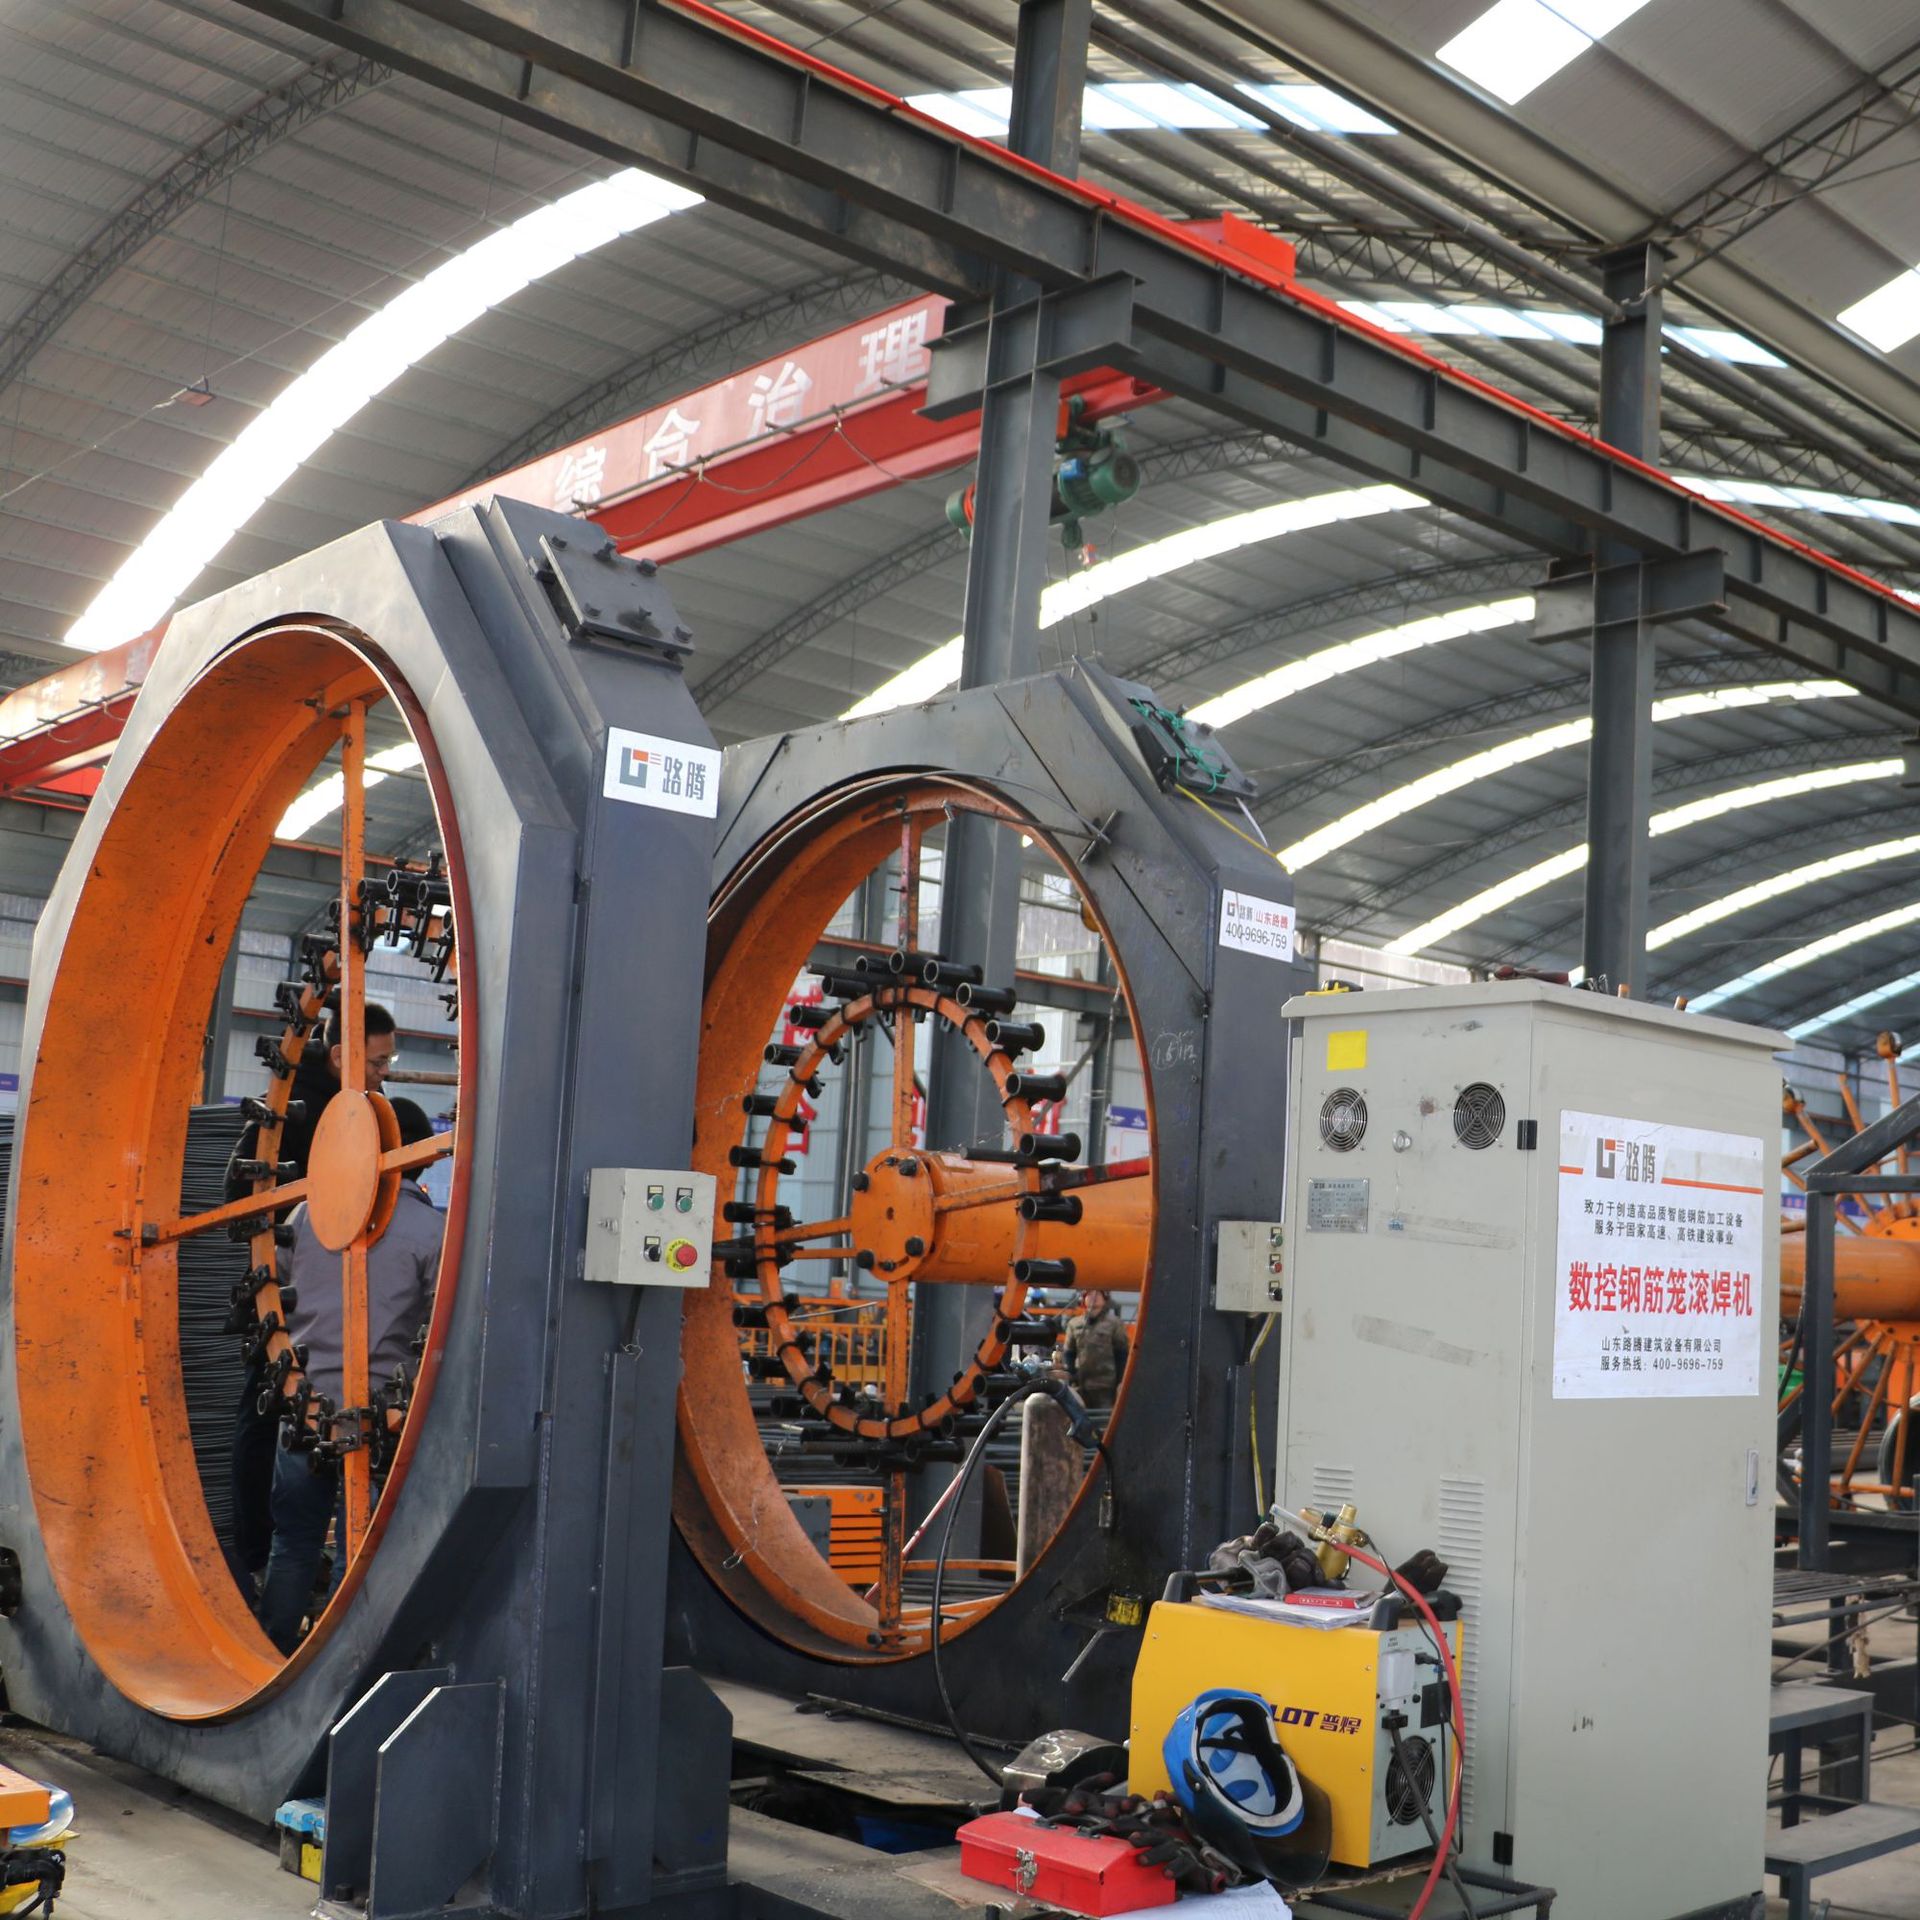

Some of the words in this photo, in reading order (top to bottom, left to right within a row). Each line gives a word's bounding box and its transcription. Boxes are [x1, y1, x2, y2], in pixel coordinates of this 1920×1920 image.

[554, 309, 929, 504] 综合治理
[662, 755, 706, 800] 路腾
[1225, 921, 1287, 950] 400-9696-759
[1625, 1141, 1656, 1184] 路腾
[1584, 1199, 1743, 1228] 致力于创造高品质智能钢筋加工设备
[1594, 1219, 1734, 1245] 服务于国家高速、高铁建设事业
[1568, 1261, 1753, 1317] 数控钢筋笼滚焊机
[1601, 1336, 1722, 1353] 山东路腾建筑设备有限公司
[1653, 1357, 1724, 1371] 400-9696-759
[1319, 1713, 1362, 1735] 普焊
